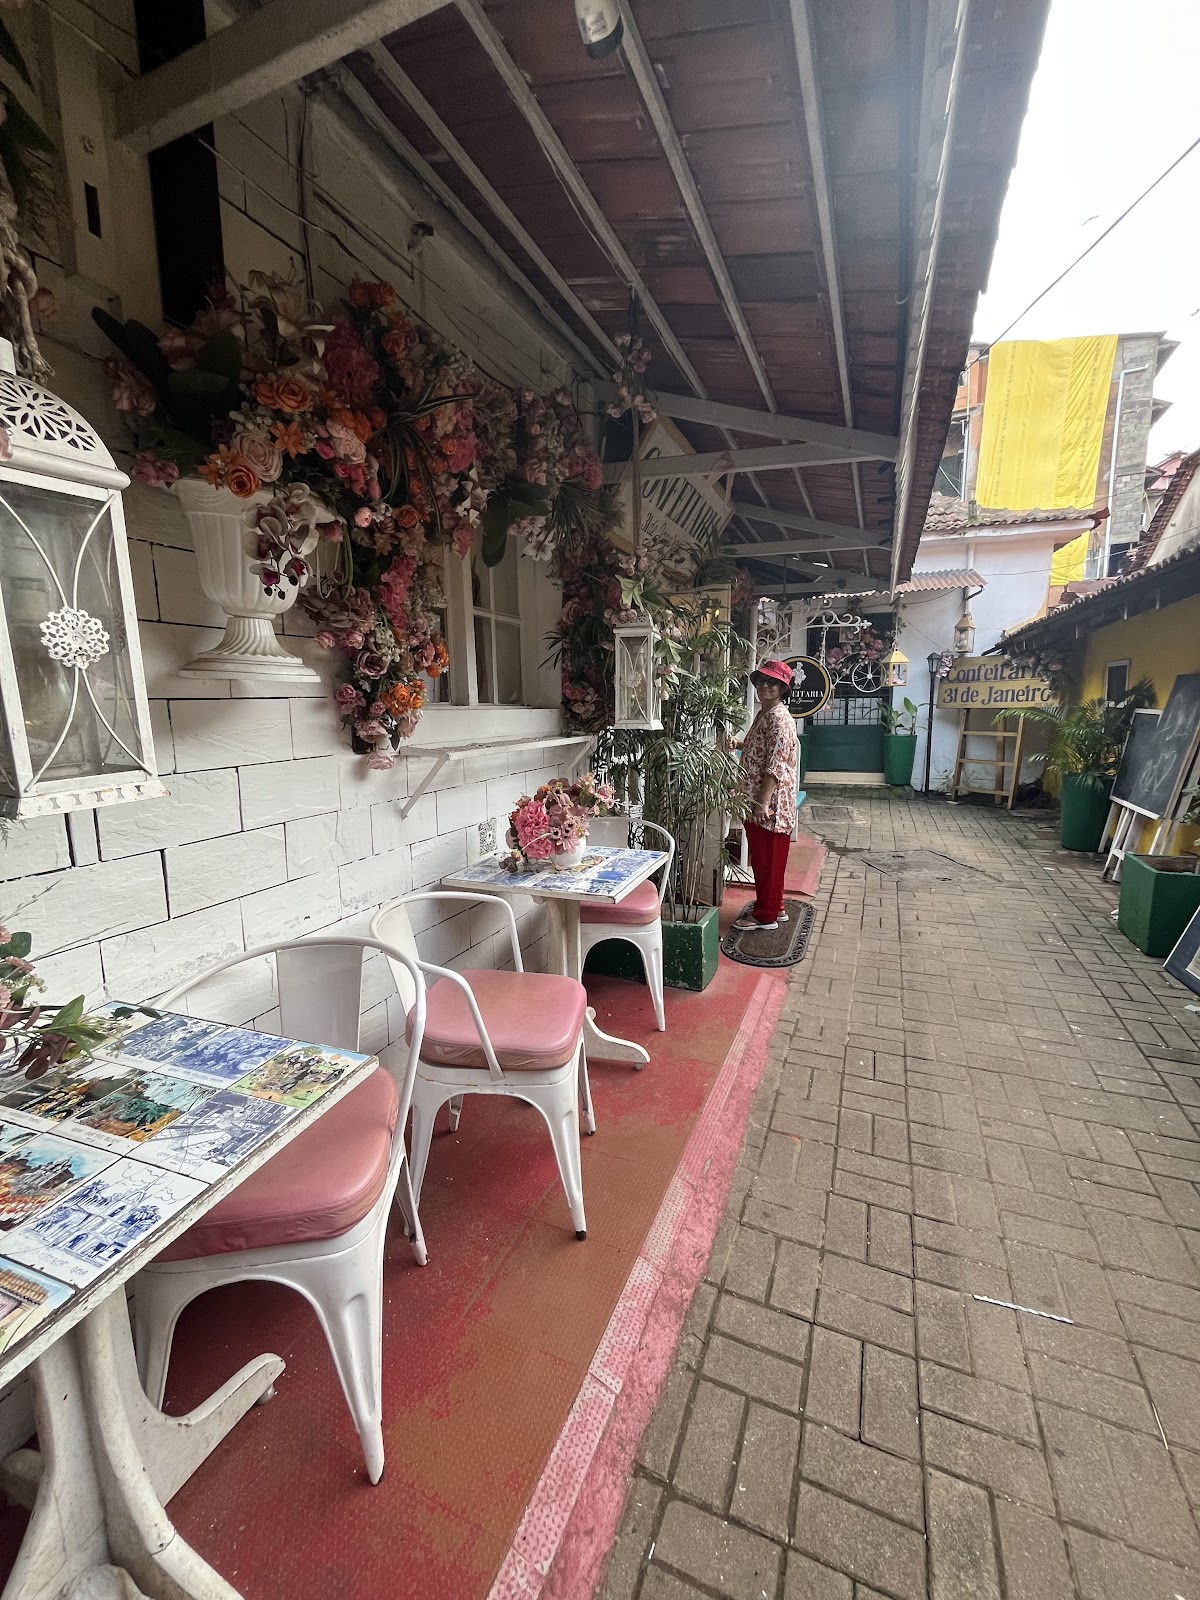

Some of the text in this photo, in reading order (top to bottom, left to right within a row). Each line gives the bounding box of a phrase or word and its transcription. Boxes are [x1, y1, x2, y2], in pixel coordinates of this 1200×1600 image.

[943, 684, 1051, 705] 31 de Janeiro
